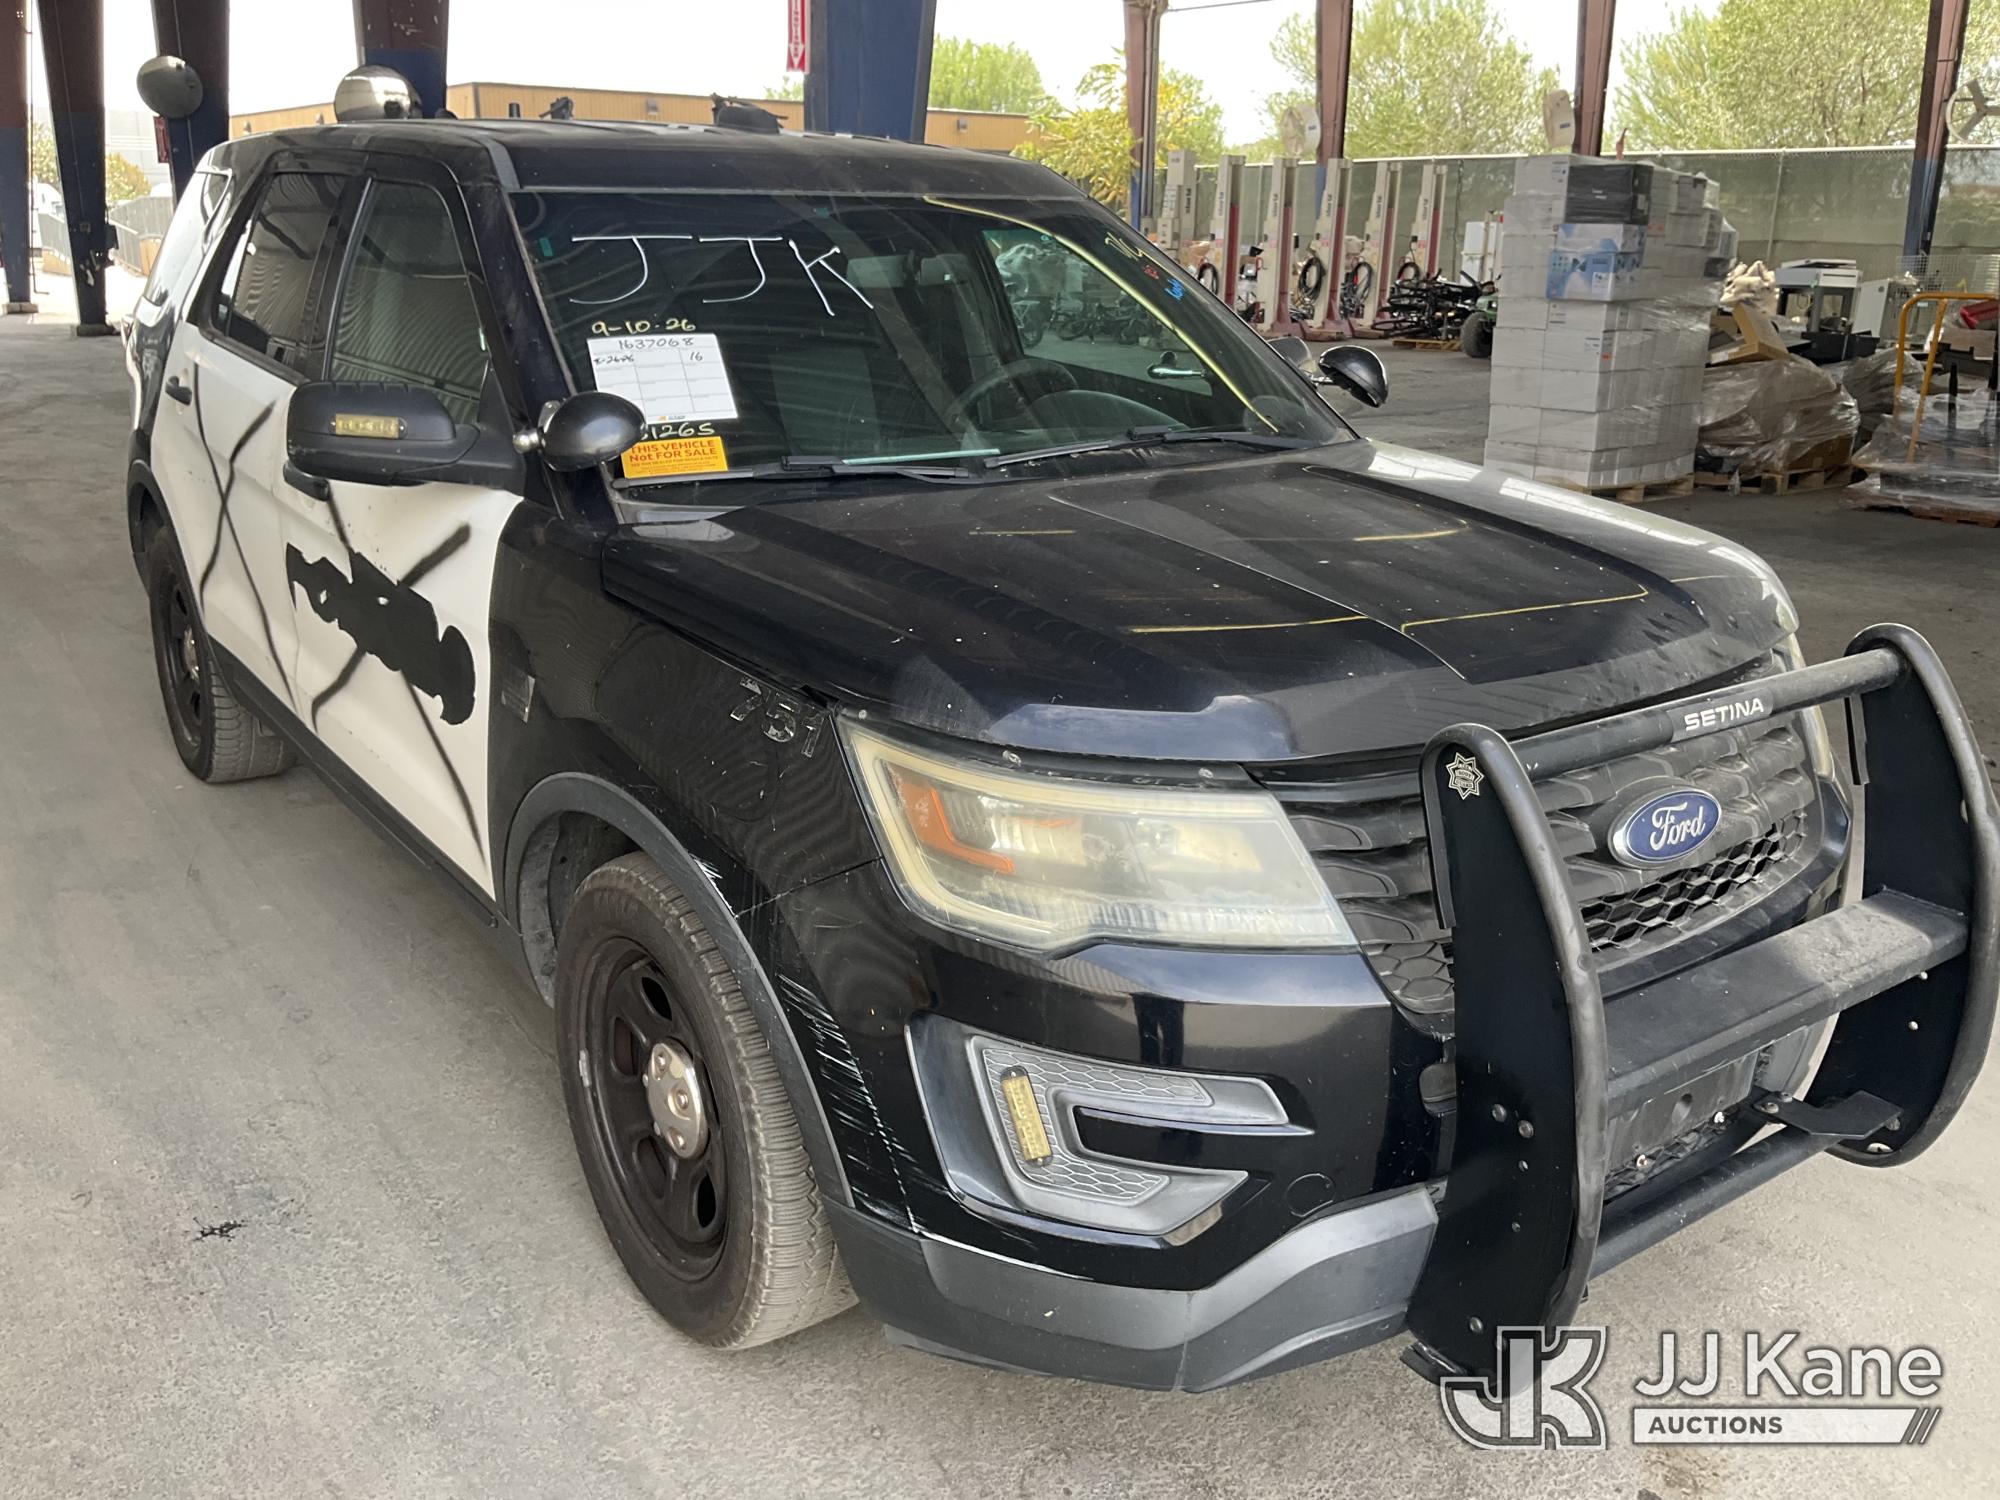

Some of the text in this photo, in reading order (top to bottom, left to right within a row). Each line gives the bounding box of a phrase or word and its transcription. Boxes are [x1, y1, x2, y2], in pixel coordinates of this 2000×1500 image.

[689, 352, 703, 362] 16
[630, 439, 715, 455] THIS VEHICLE
[655, 450, 681, 461] FOR
[684, 447, 718, 458] SALE
[1684, 697, 1765, 732] SETINA
[1650, 802, 1706, 851] Ford
